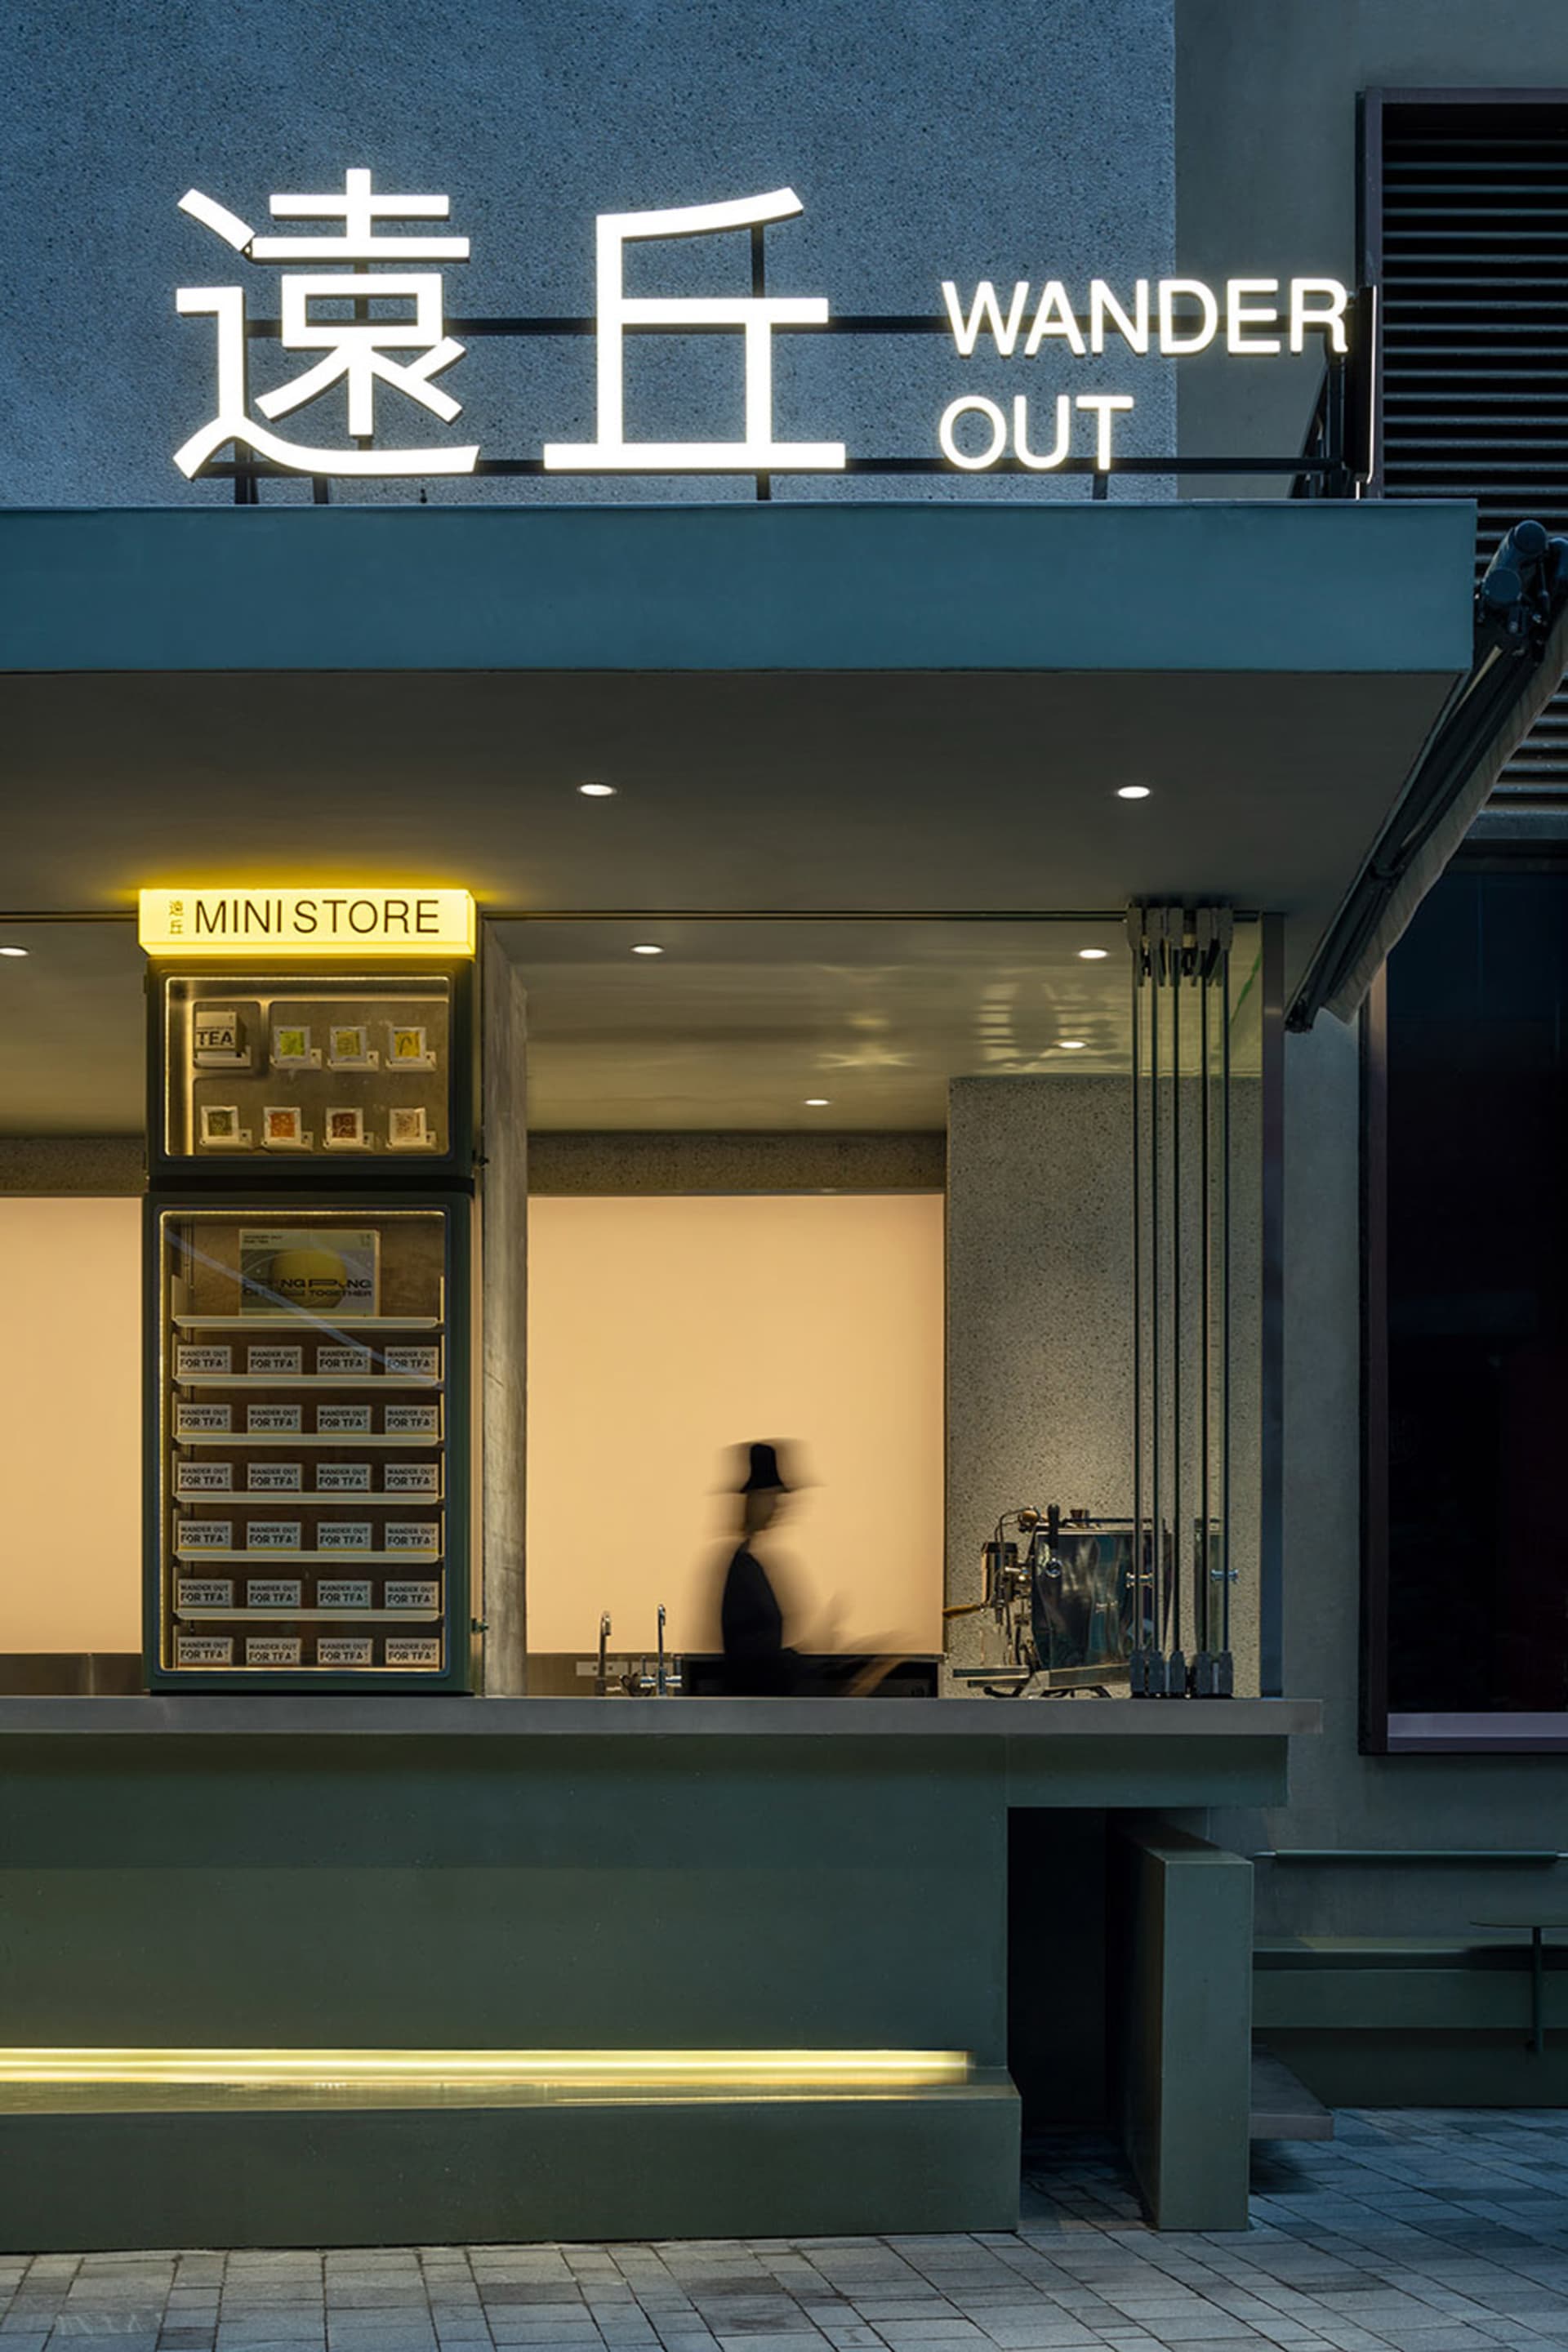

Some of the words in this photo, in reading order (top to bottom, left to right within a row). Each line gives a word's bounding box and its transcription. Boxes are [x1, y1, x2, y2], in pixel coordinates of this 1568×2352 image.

[173, 168, 846, 478] 遠丘
[942, 278, 1349, 356] WANDER
[939, 395, 1134, 471] OUT
[197, 1031, 234, 1046] TEA
